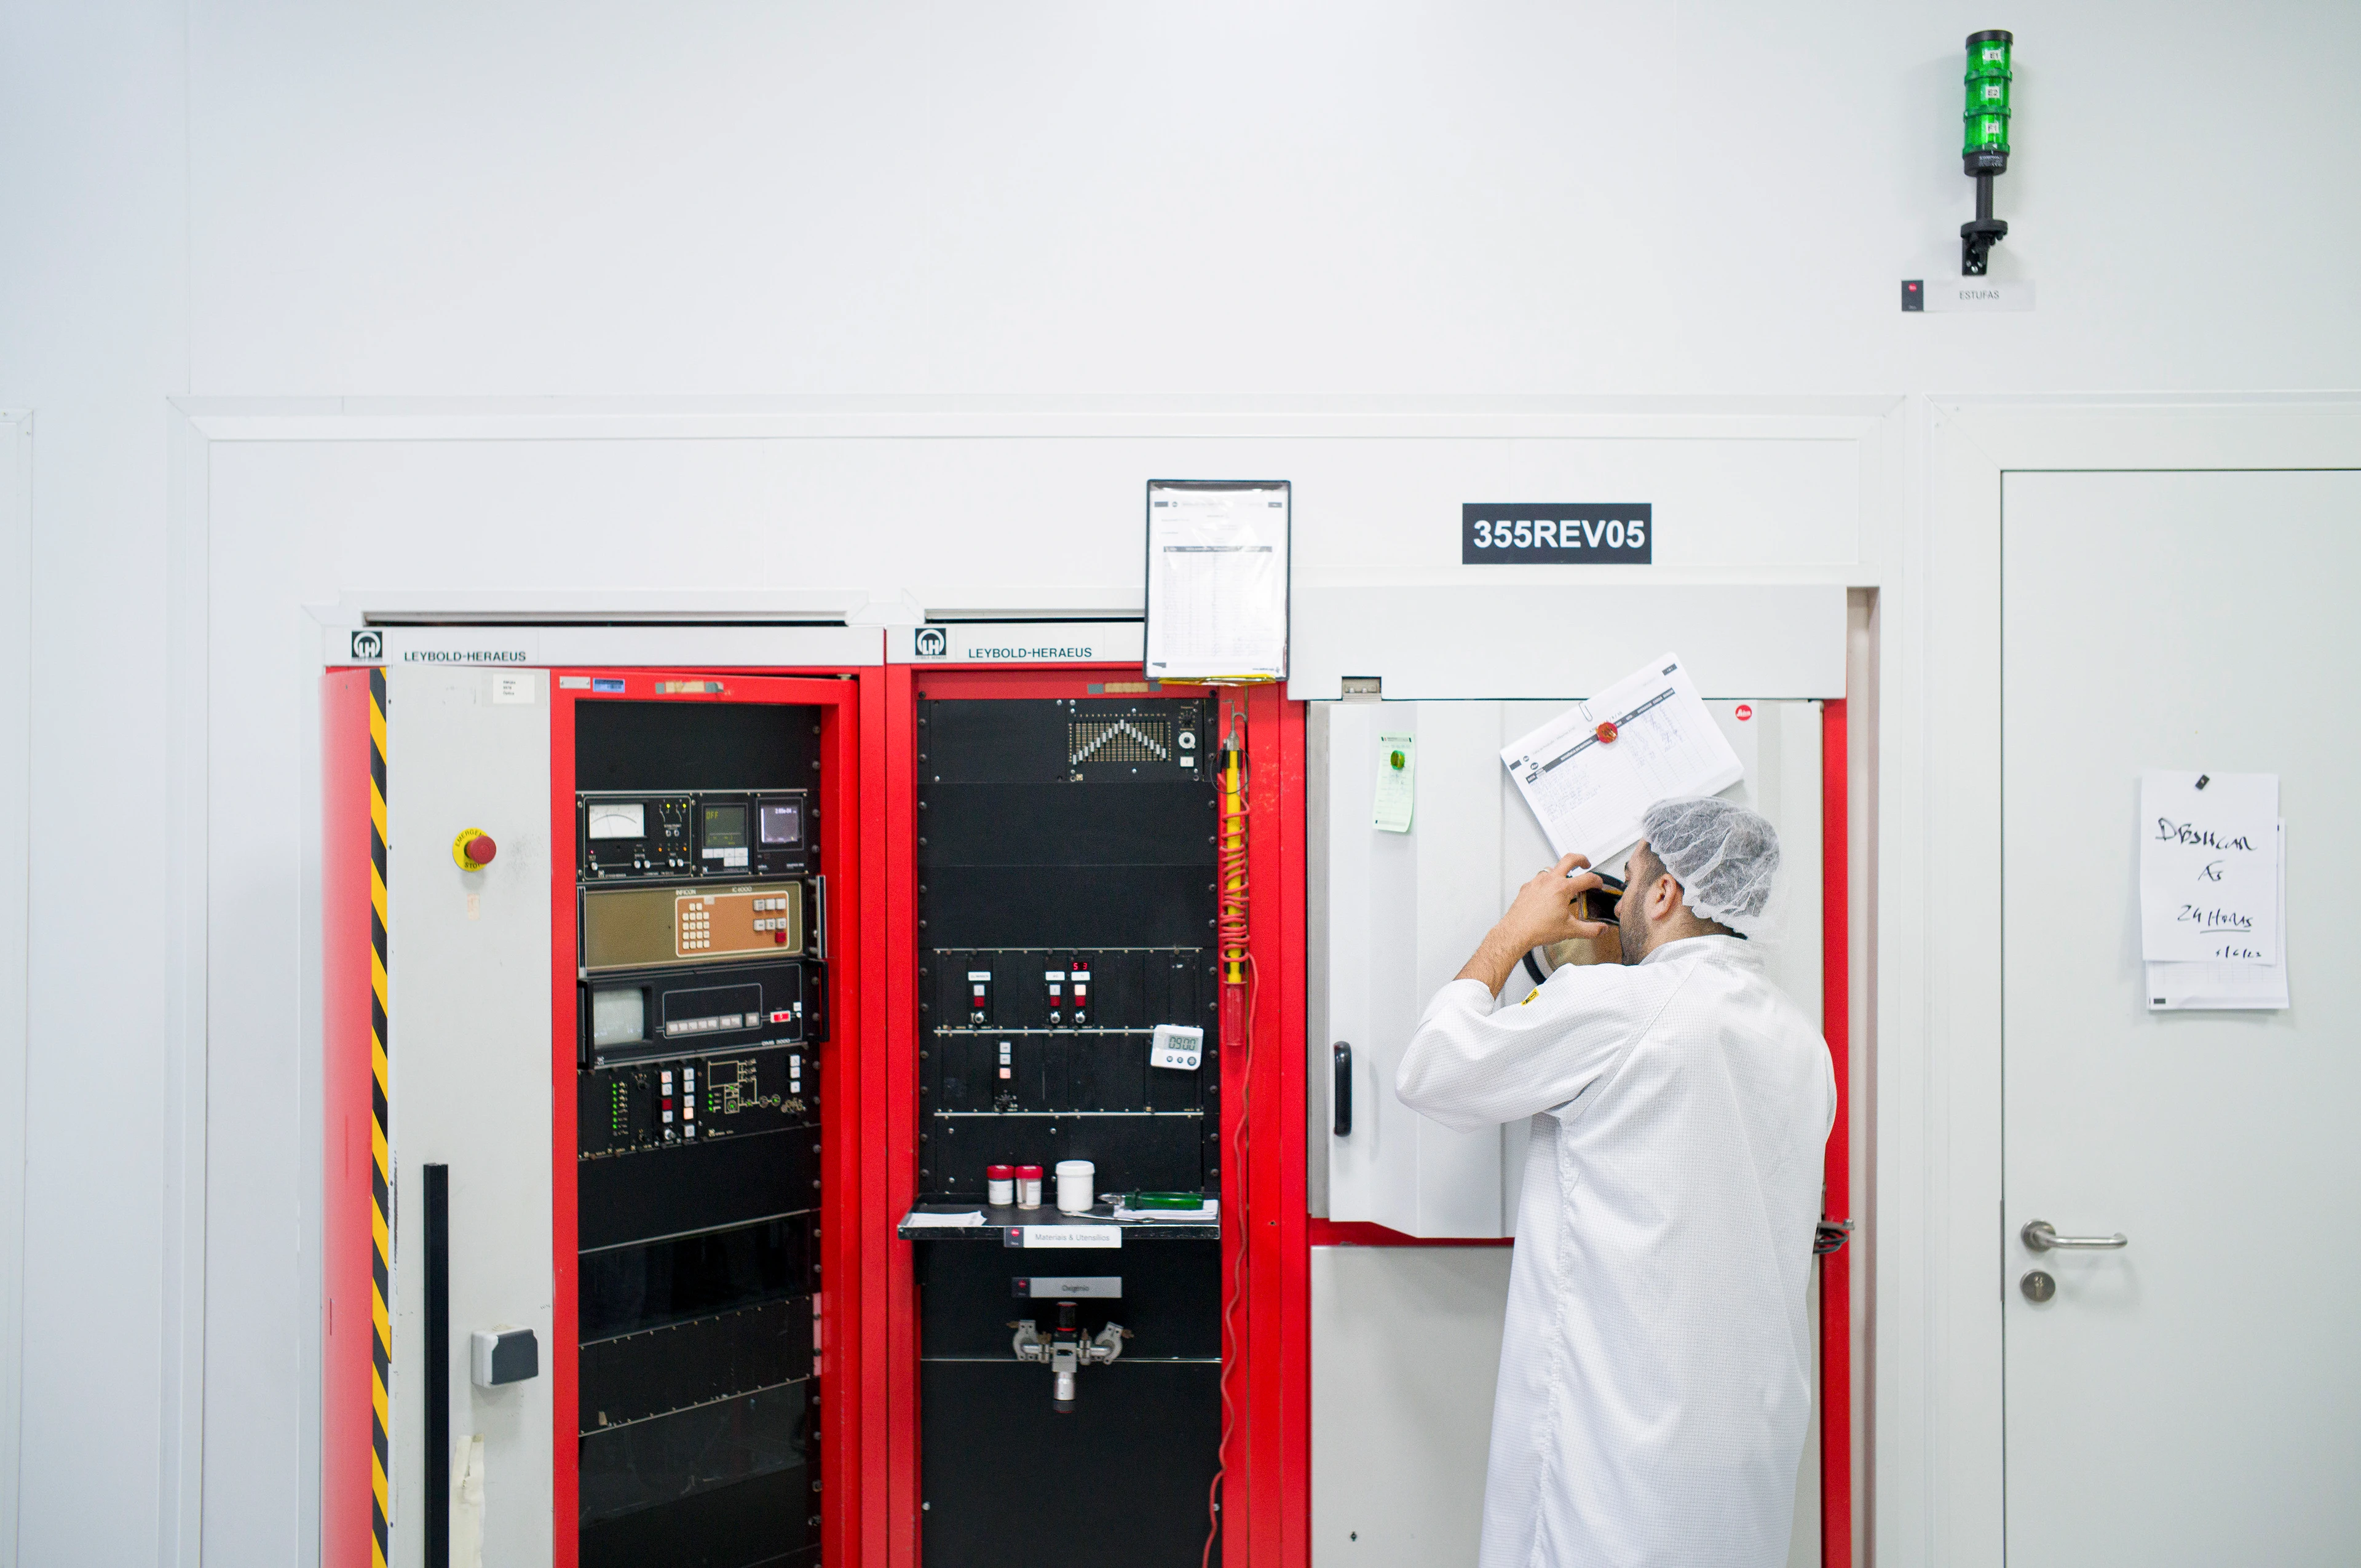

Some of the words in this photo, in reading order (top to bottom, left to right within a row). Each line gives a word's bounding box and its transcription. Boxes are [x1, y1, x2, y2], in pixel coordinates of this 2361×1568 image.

[1960, 290, 1999, 300] ESTUFAS
[1473, 520, 1645, 548] 355REV05
[404, 651, 526, 662] LEYBOLD-HERAEUS
[968, 647, 1093, 658] LEYBOLD-HERAEUS
